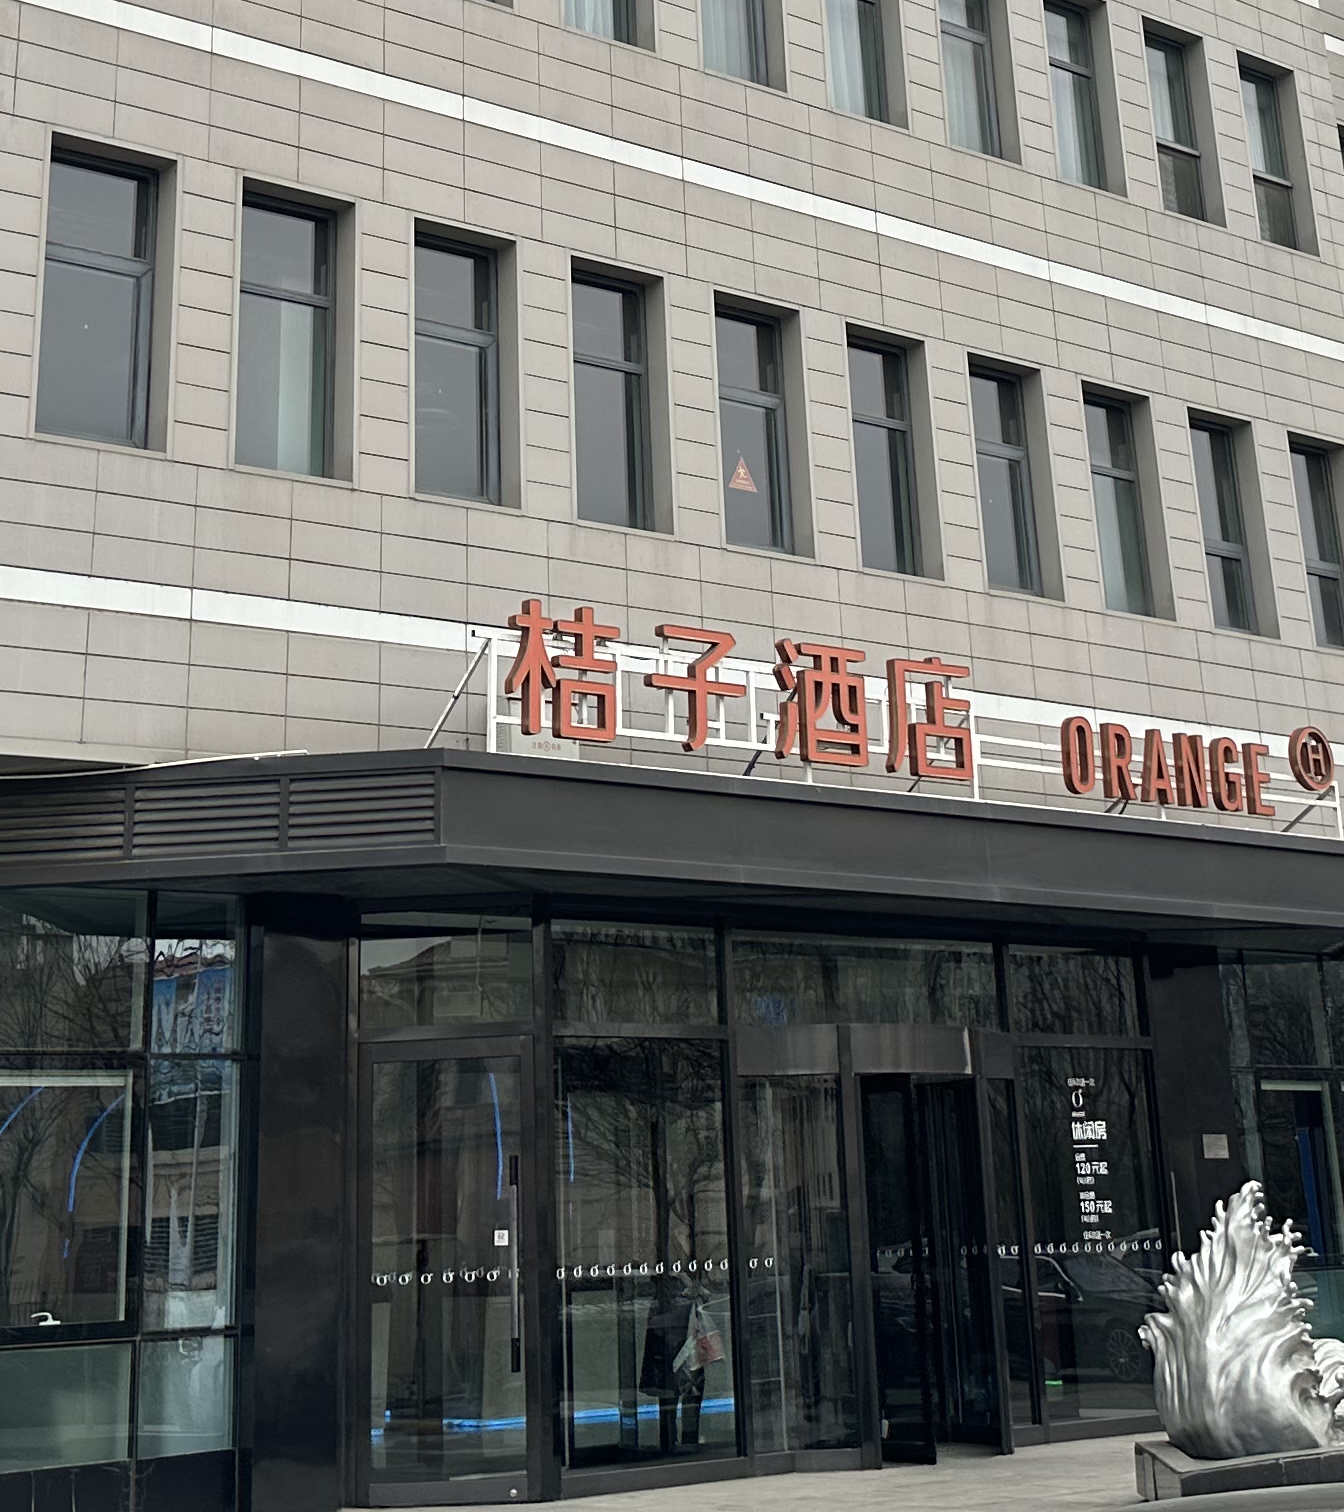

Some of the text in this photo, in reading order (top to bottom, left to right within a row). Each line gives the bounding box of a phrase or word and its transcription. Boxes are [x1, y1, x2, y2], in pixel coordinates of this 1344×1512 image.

[505, 598, 972, 780] 桔子酒店
[1060, 716, 1276, 816] ORANGE
[1071, 1120, 1107, 1140] 休闲房
